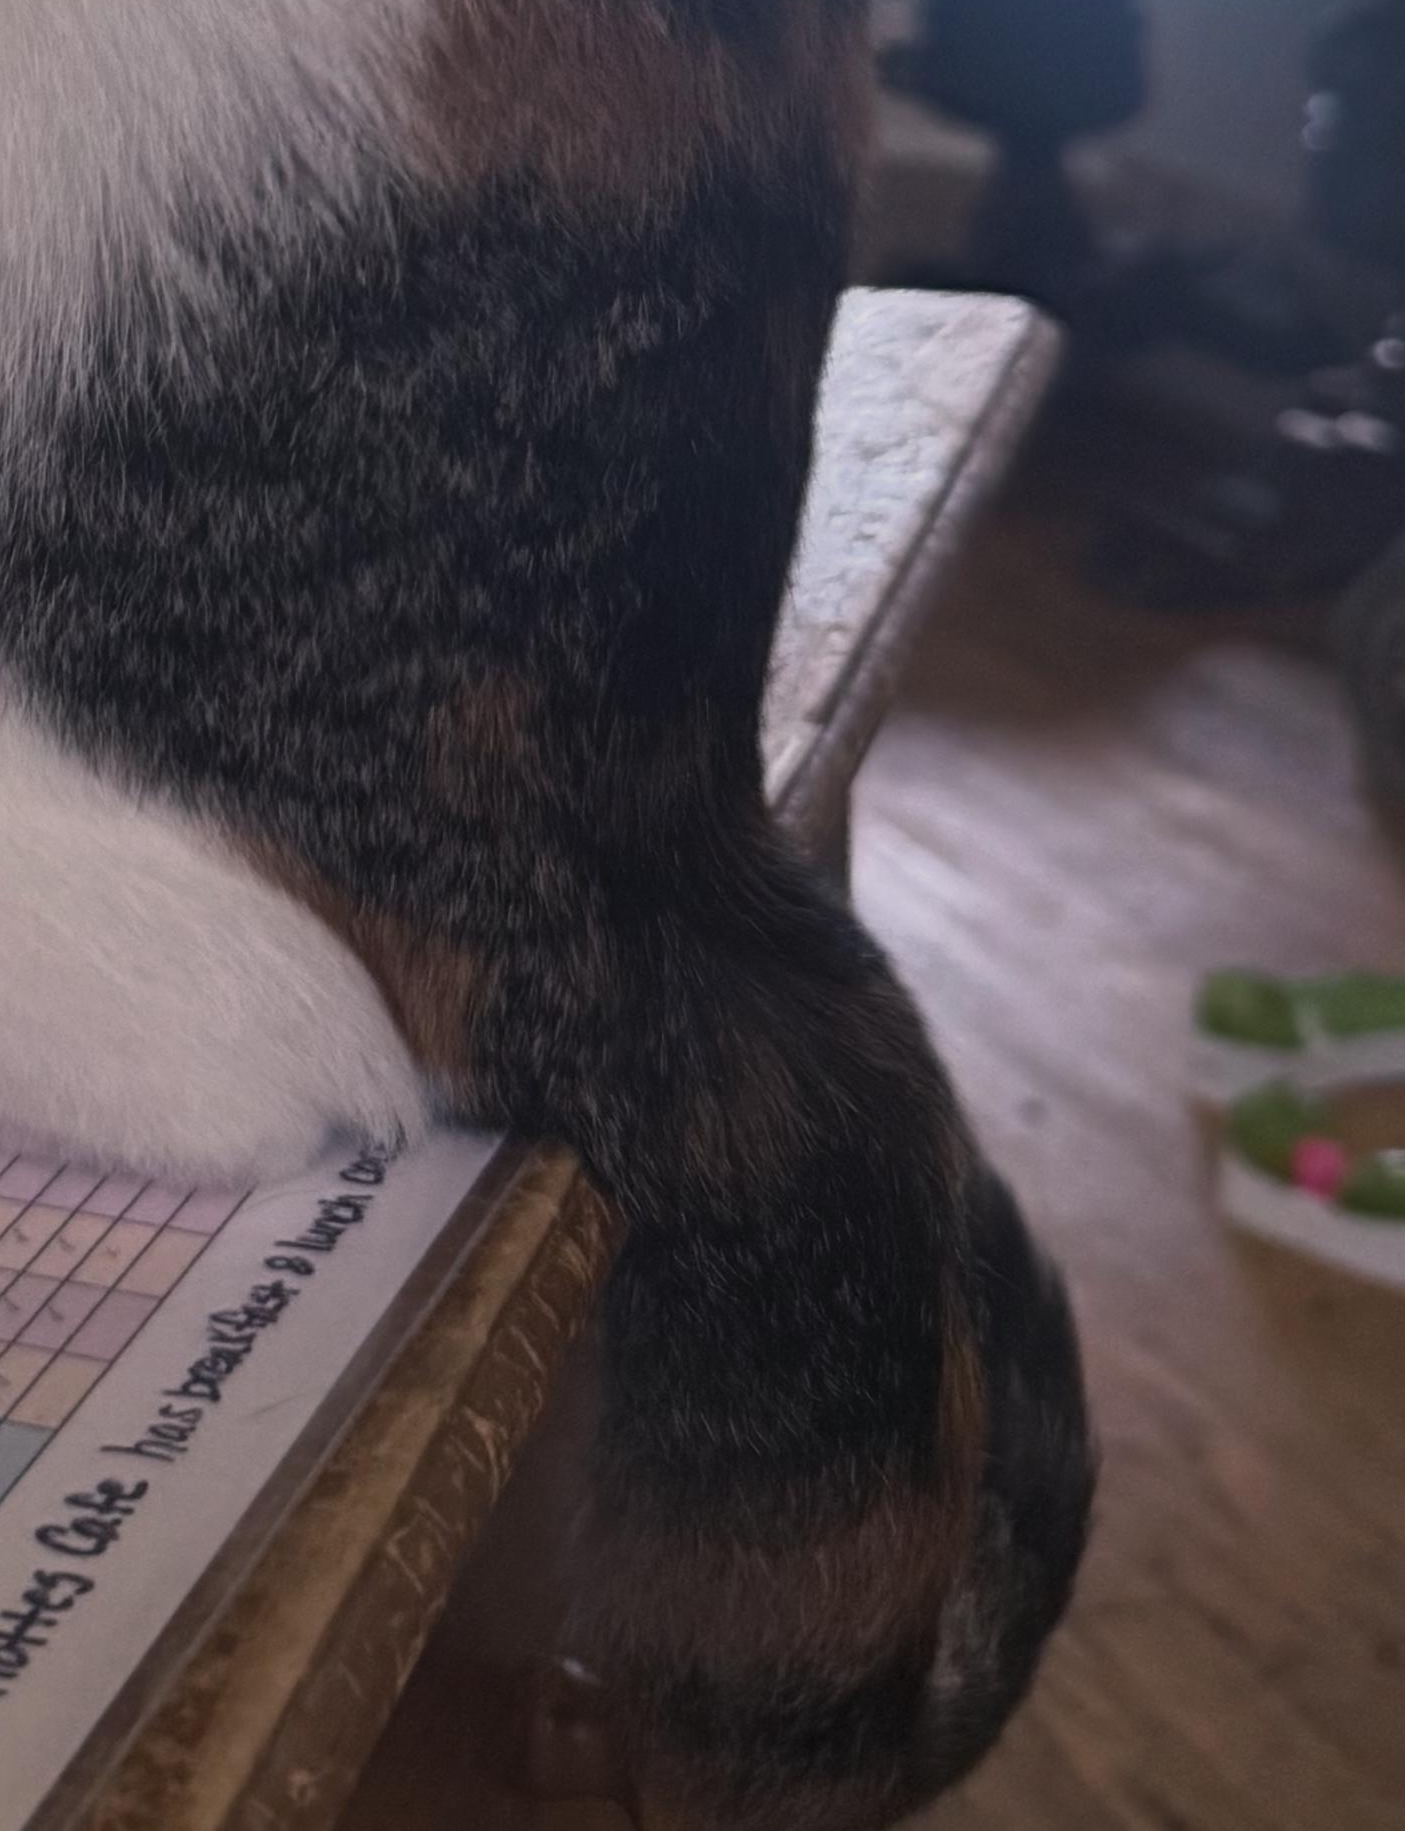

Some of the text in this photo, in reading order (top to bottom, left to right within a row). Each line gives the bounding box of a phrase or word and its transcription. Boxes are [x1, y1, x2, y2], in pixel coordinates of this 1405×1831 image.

[35, 1478, 149, 1556] Cafe
[100, 1403, 204, 1462] has
[161, 1279, 302, 1403] breakfast
[274, 1194, 375, 1252] lunch
